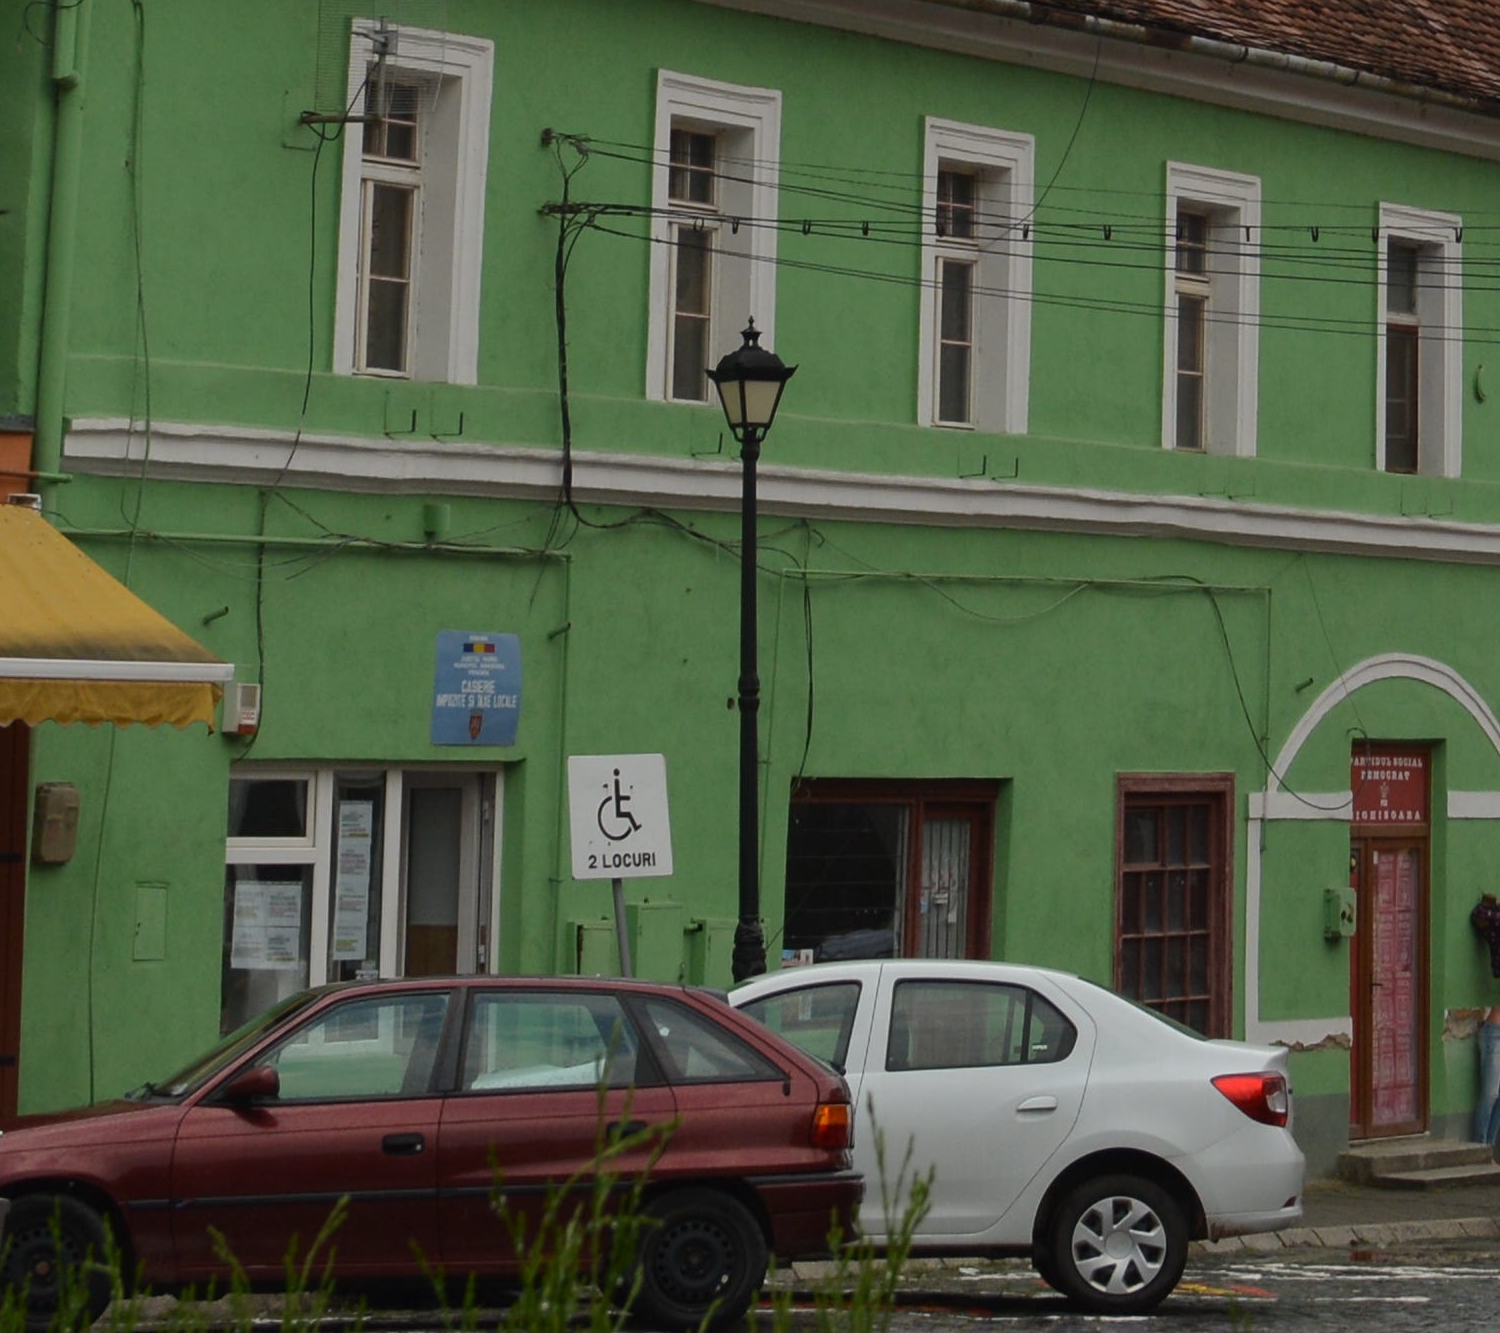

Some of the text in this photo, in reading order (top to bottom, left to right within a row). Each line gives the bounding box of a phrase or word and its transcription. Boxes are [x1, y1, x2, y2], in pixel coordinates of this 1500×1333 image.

[1351, 756, 1392, 767] ARTIDUL
[1355, 810, 1421, 821] IGHISOARA
[588, 852, 657, 870] 2 LOCURI
